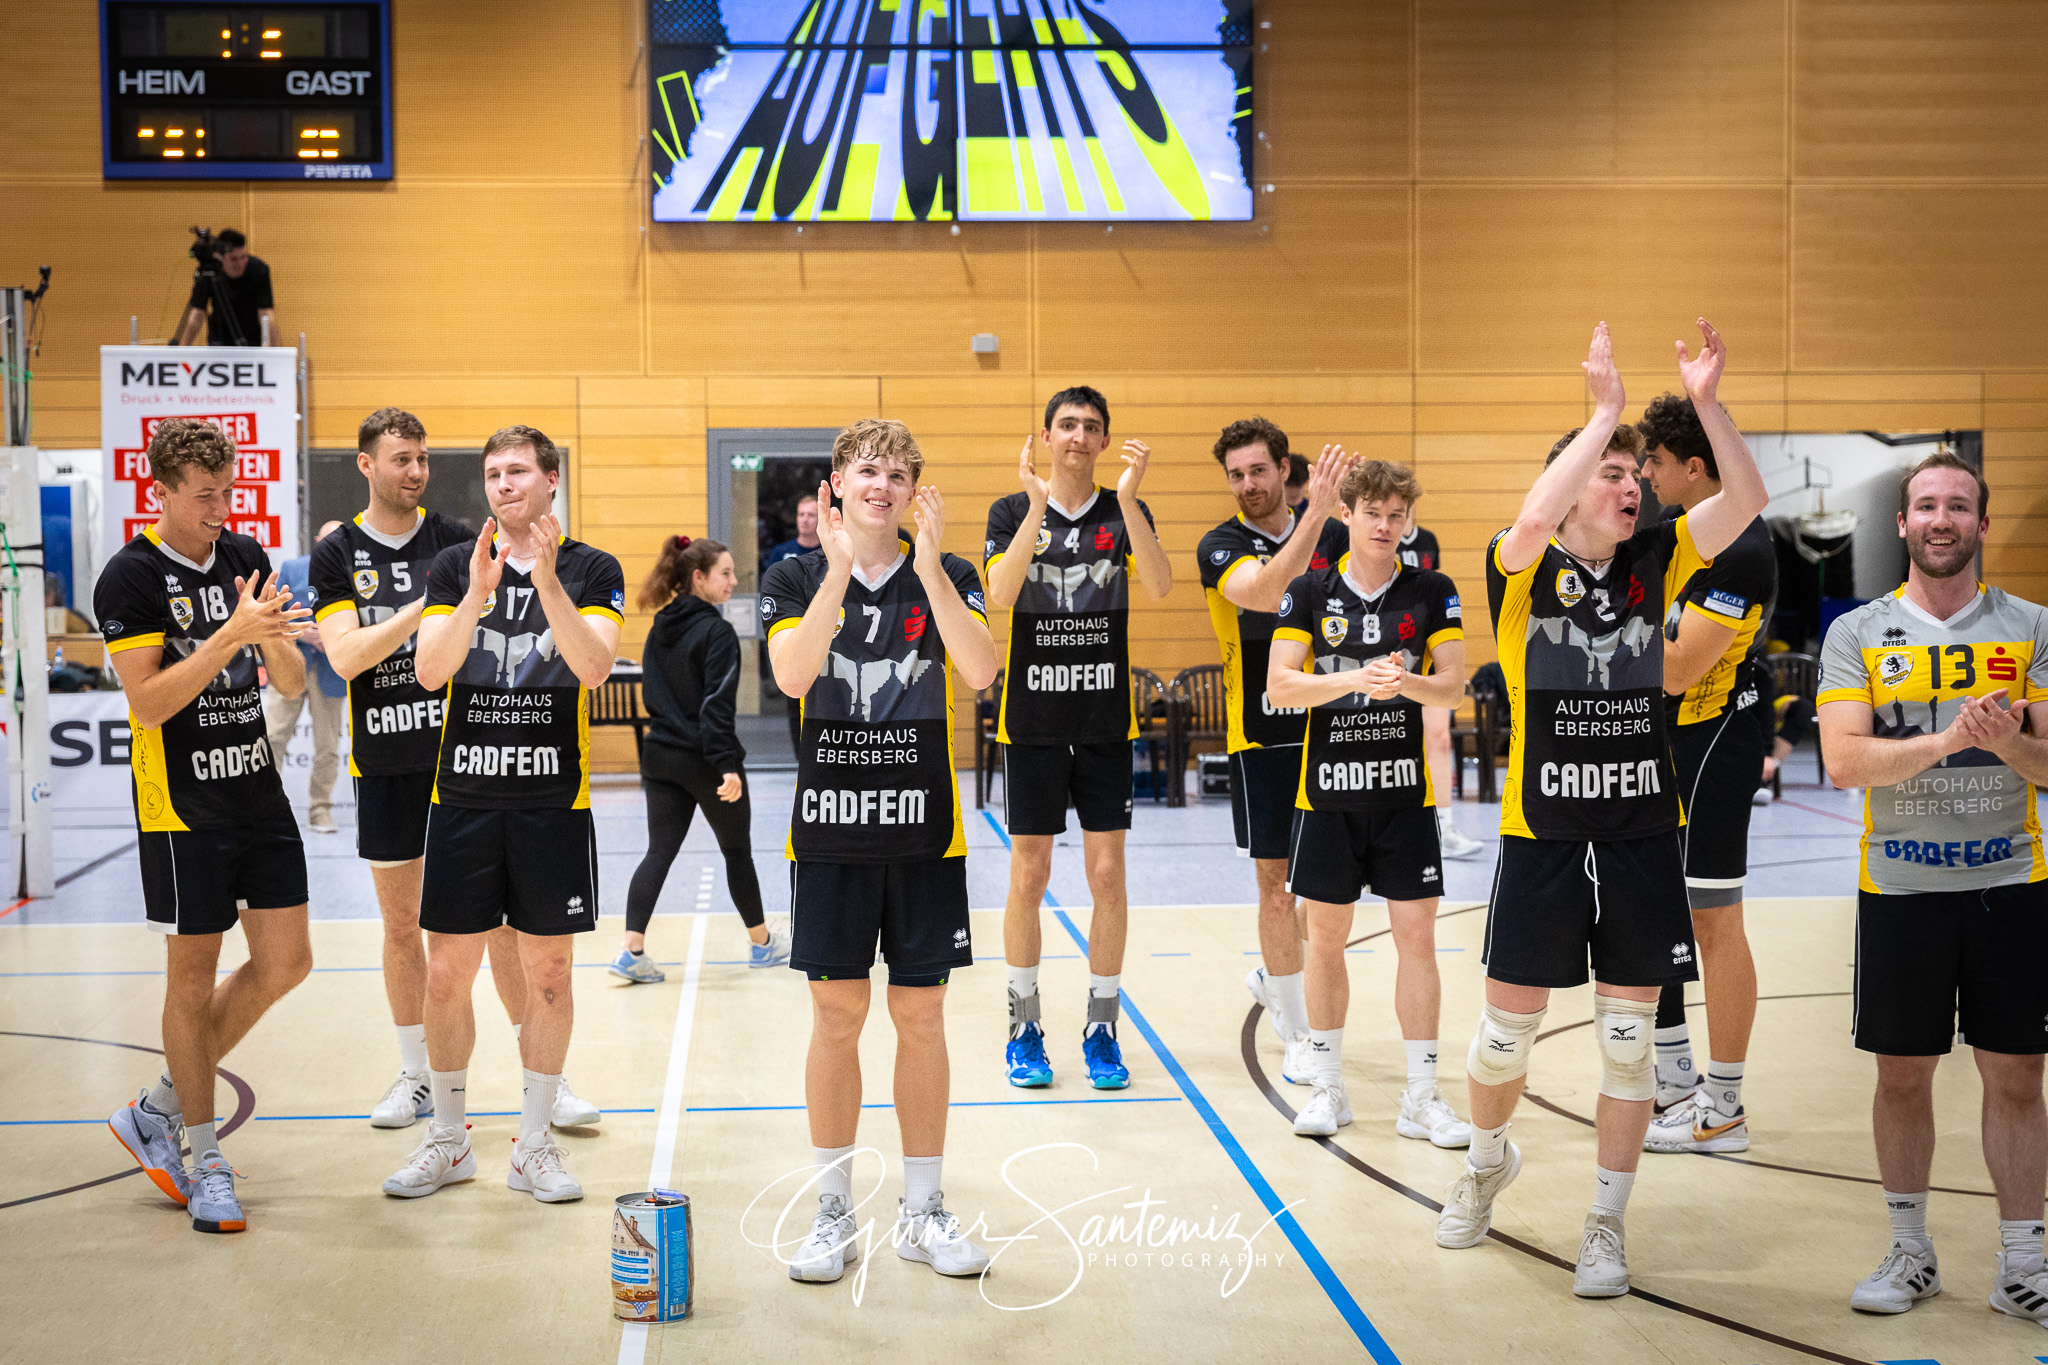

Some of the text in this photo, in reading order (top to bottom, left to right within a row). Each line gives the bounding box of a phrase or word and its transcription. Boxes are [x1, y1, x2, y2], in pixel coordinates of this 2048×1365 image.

[119, 70, 205, 95] HEIM
[286, 70, 372, 96] GAST
[304, 165, 373, 179] PEWETA
[121, 362, 277, 387] MEYSEL
[121, 393, 161, 405] Druck
[180, 393, 276, 405] Werbetechnik
[1063, 527, 1080, 554] 4
[391, 561, 412, 592] 5
[199, 585, 229, 623] 18
[506, 586, 534, 621] 17
[1591, 588, 1616, 622] 2
[1712, 589, 1746, 607] RÜGER
[863, 603, 882, 644] 7
[1035, 617, 1109, 631] AUTOHAUS
[1362, 614, 1381, 645] 8
[1036, 632, 1109, 646] EBERSBERG
[1882, 639, 1907, 647] errea
[375, 657, 415, 675] AUTO
[1928, 644, 1976, 689] 13
[373, 673, 416, 689] EBERS
[1027, 662, 1115, 692] CADFEM
[470, 693, 552, 707] AUTOHAUS
[1555, 697, 1650, 715] AUTOHAUS
[467, 710, 552, 724] EBERSBERG
[1331, 710, 1406, 728] AUTOHAUS
[1329, 726, 1406, 743] EBERSBERG
[1555, 718, 1651, 737] EBERSBERG
[819, 729, 917, 745] AUTOHAUS
[816, 748, 918, 764] EBERSBERG
[1895, 775, 2003, 795] AUTOHAUS
[1895, 796, 2003, 816] EBERSBERG
[1673, 955, 1691, 965] errea
